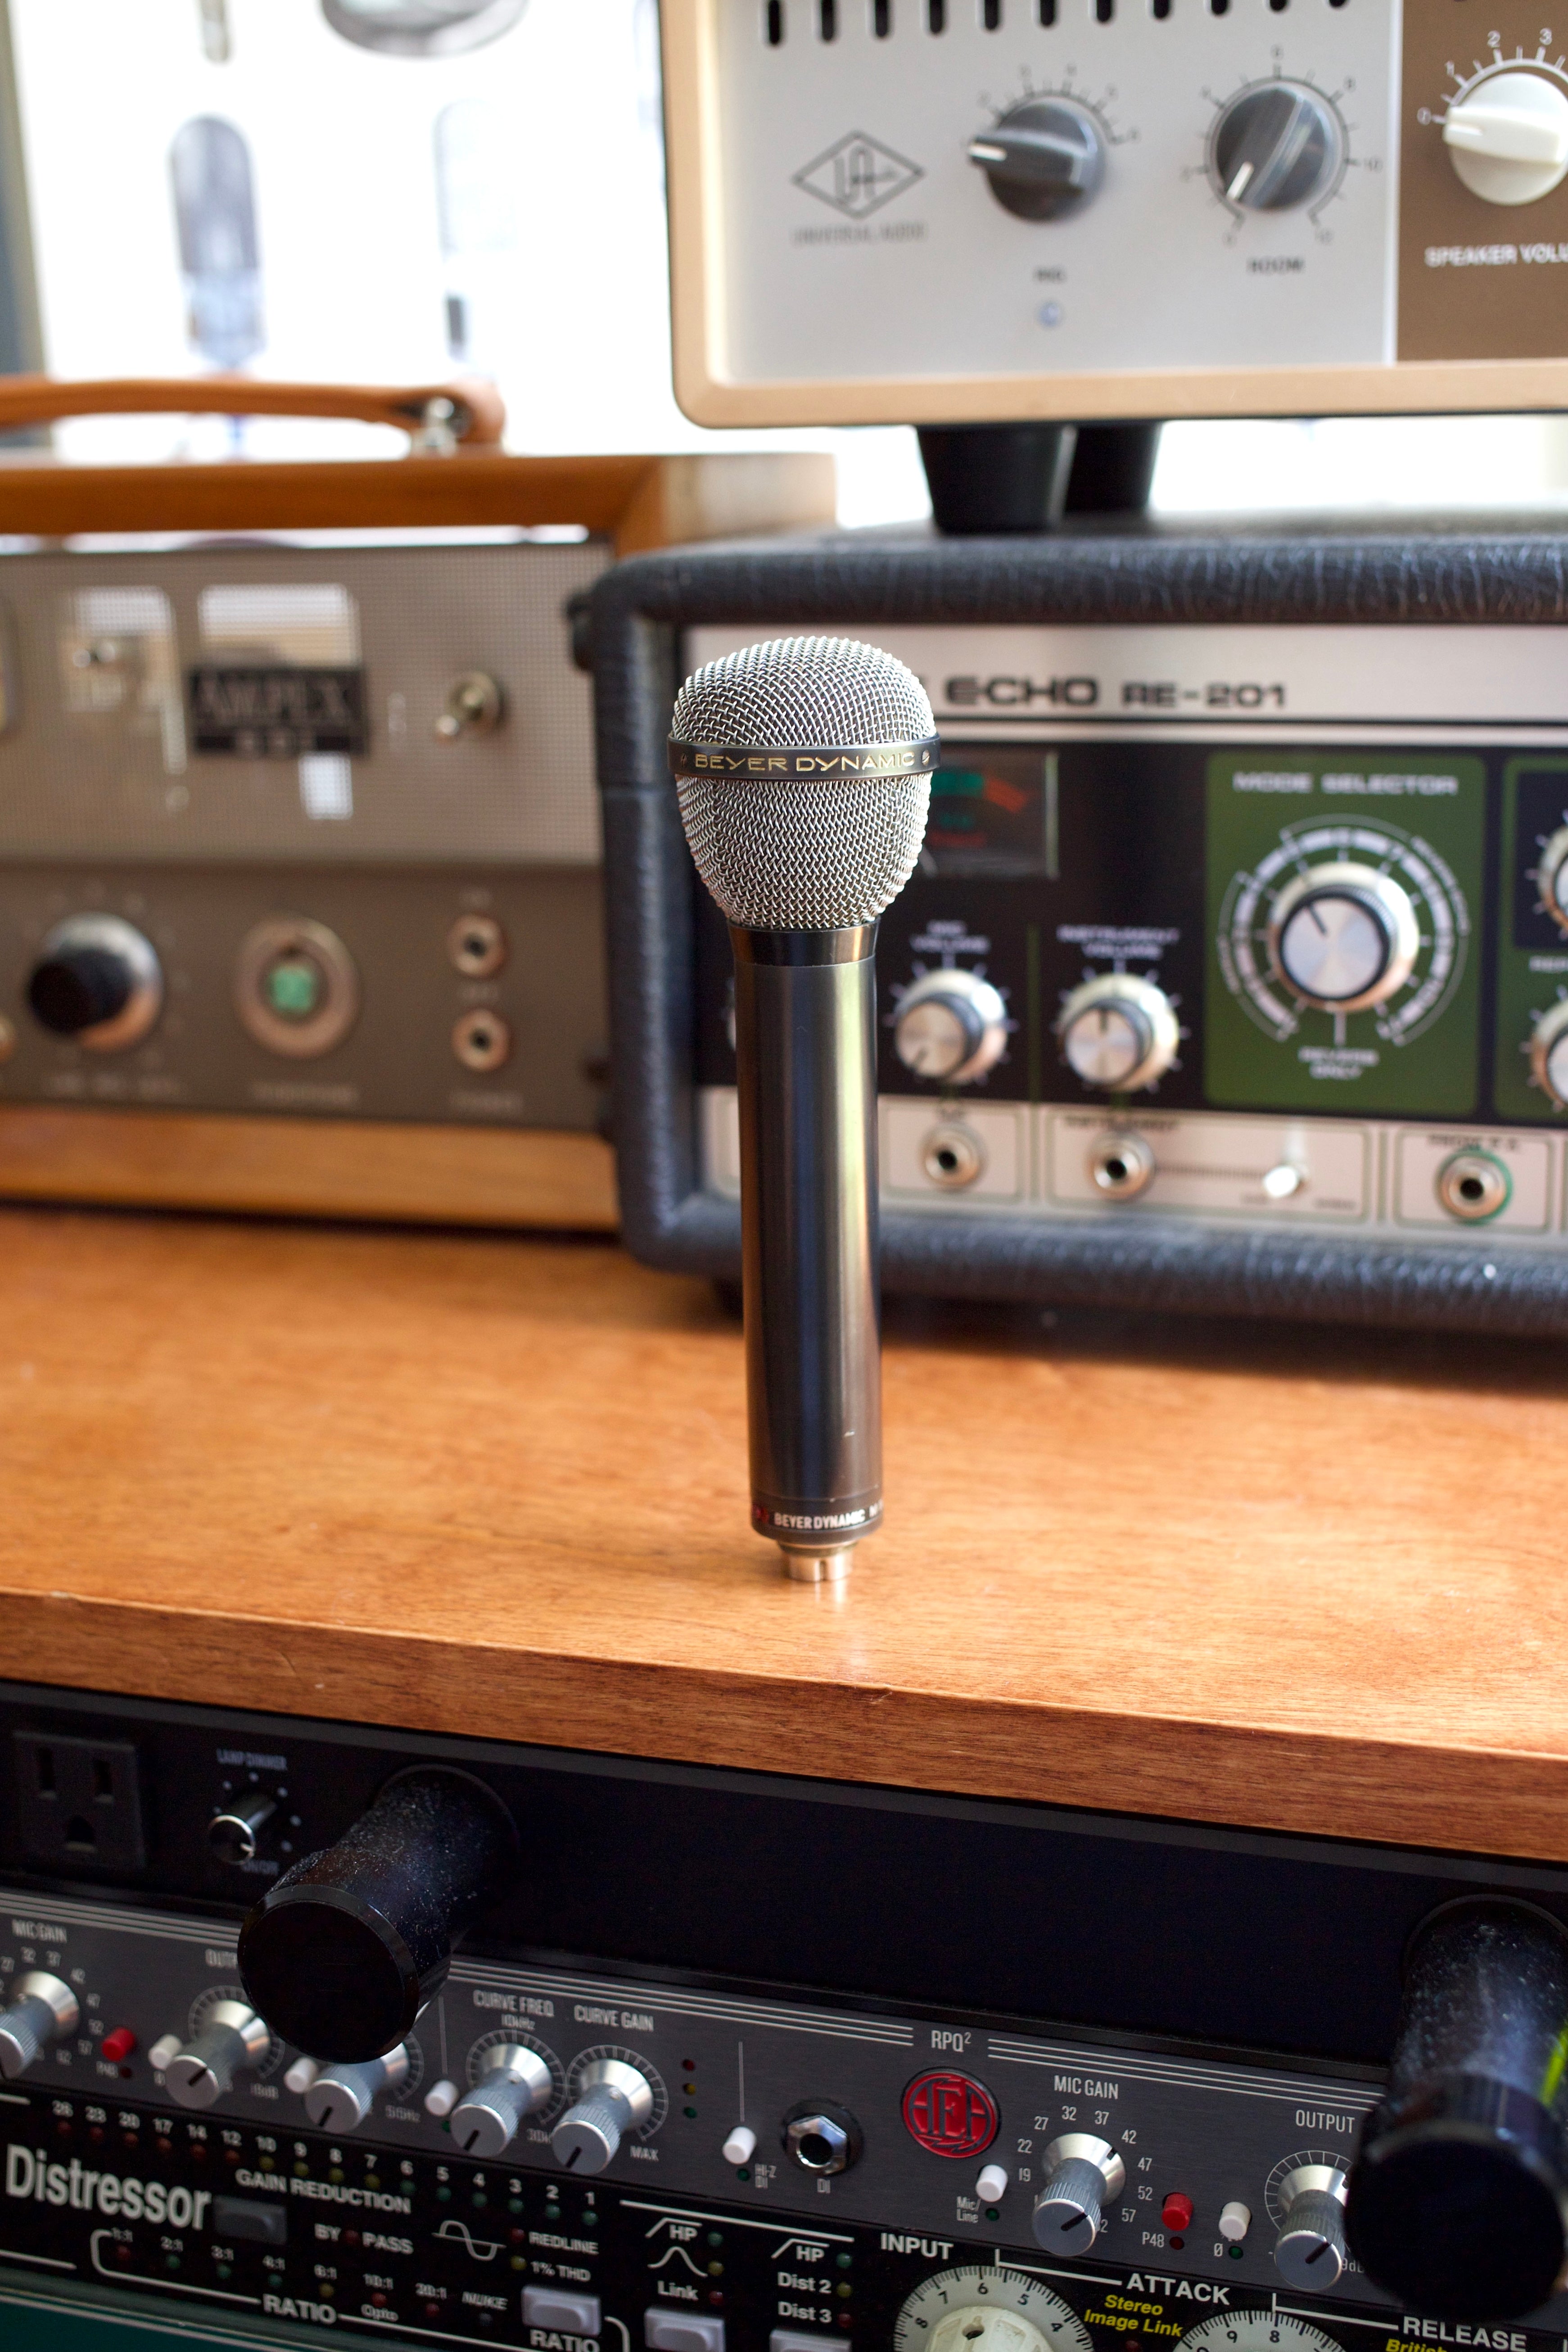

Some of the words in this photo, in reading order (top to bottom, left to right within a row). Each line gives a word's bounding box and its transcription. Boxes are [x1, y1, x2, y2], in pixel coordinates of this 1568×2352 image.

[1487, 30, 1500, 48] 2
[1540, 27, 1553, 45] 3
[1445, 60, 1455, 77] 1
[1424, 245, 1518, 267] SPEAKER
[945, 675, 1101, 706] ECHO
[1121, 681, 1287, 707] RE-201
[694, 754, 788, 772] BEYER
[796, 751, 916, 773] DYNAMIC
[1321, 773, 1459, 796] SELECTOR
[473, 1990, 517, 2013] CURVE
[519, 1996, 555, 2017] FREQ
[574, 2004, 619, 2026] CURVE
[621, 2011, 654, 2032] GAIN
[1054, 2075, 1082, 2094] MIC
[1084, 2079, 1119, 2100] GAIN
[1062, 2105, 1077, 2121] 32
[1094, 2110, 1110, 2126] 37
[1295, 2109, 1356, 2134] OUTPUT
[1034, 2116, 1048, 2131] 27
[1121, 2129, 1137, 2144] 42
[630, 2145, 660, 2162] MAX
[1017, 2138, 1033, 2154] 22
[153, 2117, 173, 2134] 17
[187, 2124, 208, 2141] 14
[221, 2130, 242, 2147] 12
[294, 2142, 307, 2158] 9
[329, 2148, 343, 2164] 8
[364, 2153, 378, 2169] 7
[400, 2160, 414, 2176] 6
[436, 2166, 449, 2182] 5
[472, 2173, 486, 2188] 4
[509, 2179, 522, 2194] 3
[546, 2185, 559, 2200] 2
[585, 2191, 595, 2206] 1
[1138, 2157, 1153, 2171] 47
[1018, 2167, 1031, 2182] 19
[5, 2143, 212, 2231] Distressor
[235, 2168, 287, 2194] GAIN
[290, 2177, 411, 2215] REDUCTION
[817, 2178, 831, 2194] DI
[1138, 2186, 1153, 2201] 52
[957, 2209, 979, 2223] Line
[1121, 2208, 1137, 2223] 57
[314, 2223, 342, 2242] BY
[362, 2232, 414, 2255] PASS
[669, 2224, 698, 2241] HP
[1142, 2231, 1165, 2248] P48
[528, 2231, 599, 2255] REDLINE
[881, 2232, 954, 2260] INPUT
[796, 2245, 825, 2263] HP
[530, 2261, 556, 2276] 1%
[556, 2265, 591, 2282] THD
[657, 2280, 699, 2301] Link
[777, 2271, 816, 2293] Dist
[819, 2280, 832, 2294] 2
[978, 2282, 989, 2295] 6
[1126, 2272, 1231, 2306] ATTACK
[461, 2291, 509, 2311] NUKE
[938, 2291, 949, 2304] 7
[1017, 2293, 1029, 2306] 5
[1104, 2294, 1163, 2316] Stereo
[262, 2293, 337, 2325] RATIO
[361, 2304, 399, 2322] Opto
[777, 2301, 816, 2321] Dist
[819, 2308, 832, 2324] 3
[915, 2317, 928, 2329] 8
[1051, 2322, 1064, 2333] 4
[1083, 2309, 1139, 2330] Image
[1143, 2320, 1184, 2338] Link
[529, 2329, 600, 2352] RATIO
[1227, 2330, 1238, 2343] 9
[1269, 2329, 1280, 2343] 8
[1403, 2316, 1527, 2352] RELEASE
